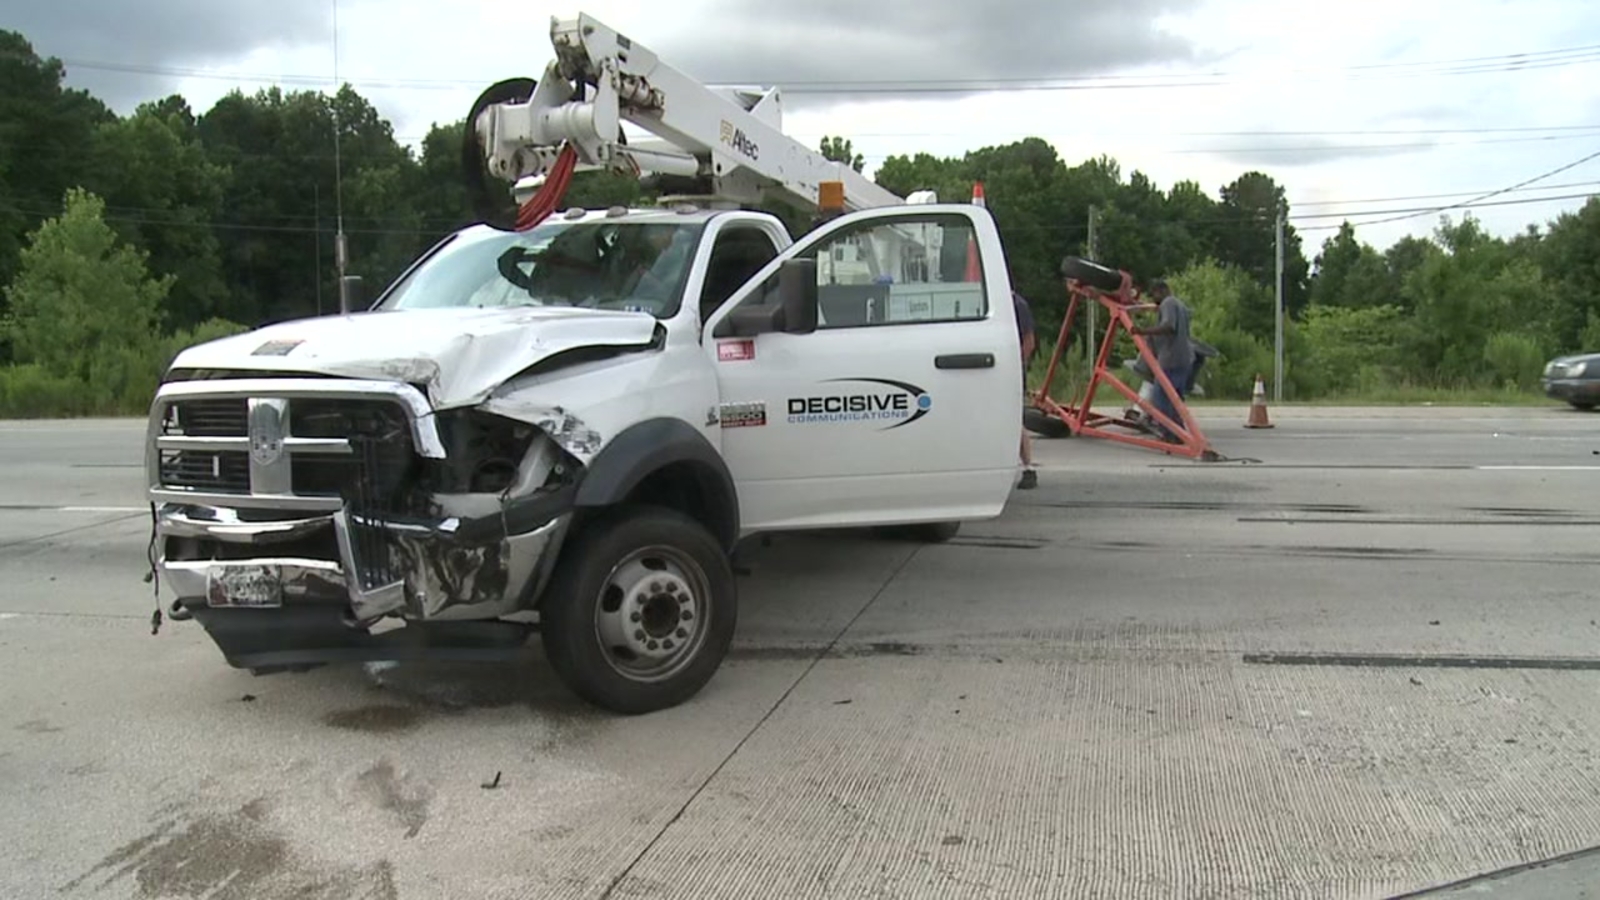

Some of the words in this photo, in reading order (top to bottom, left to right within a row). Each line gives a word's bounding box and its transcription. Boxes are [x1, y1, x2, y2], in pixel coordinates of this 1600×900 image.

[732, 128, 759, 160] Altec
[788, 393, 908, 415] DECISIVE
[787, 409, 909, 424] COMMUNICATIONS
